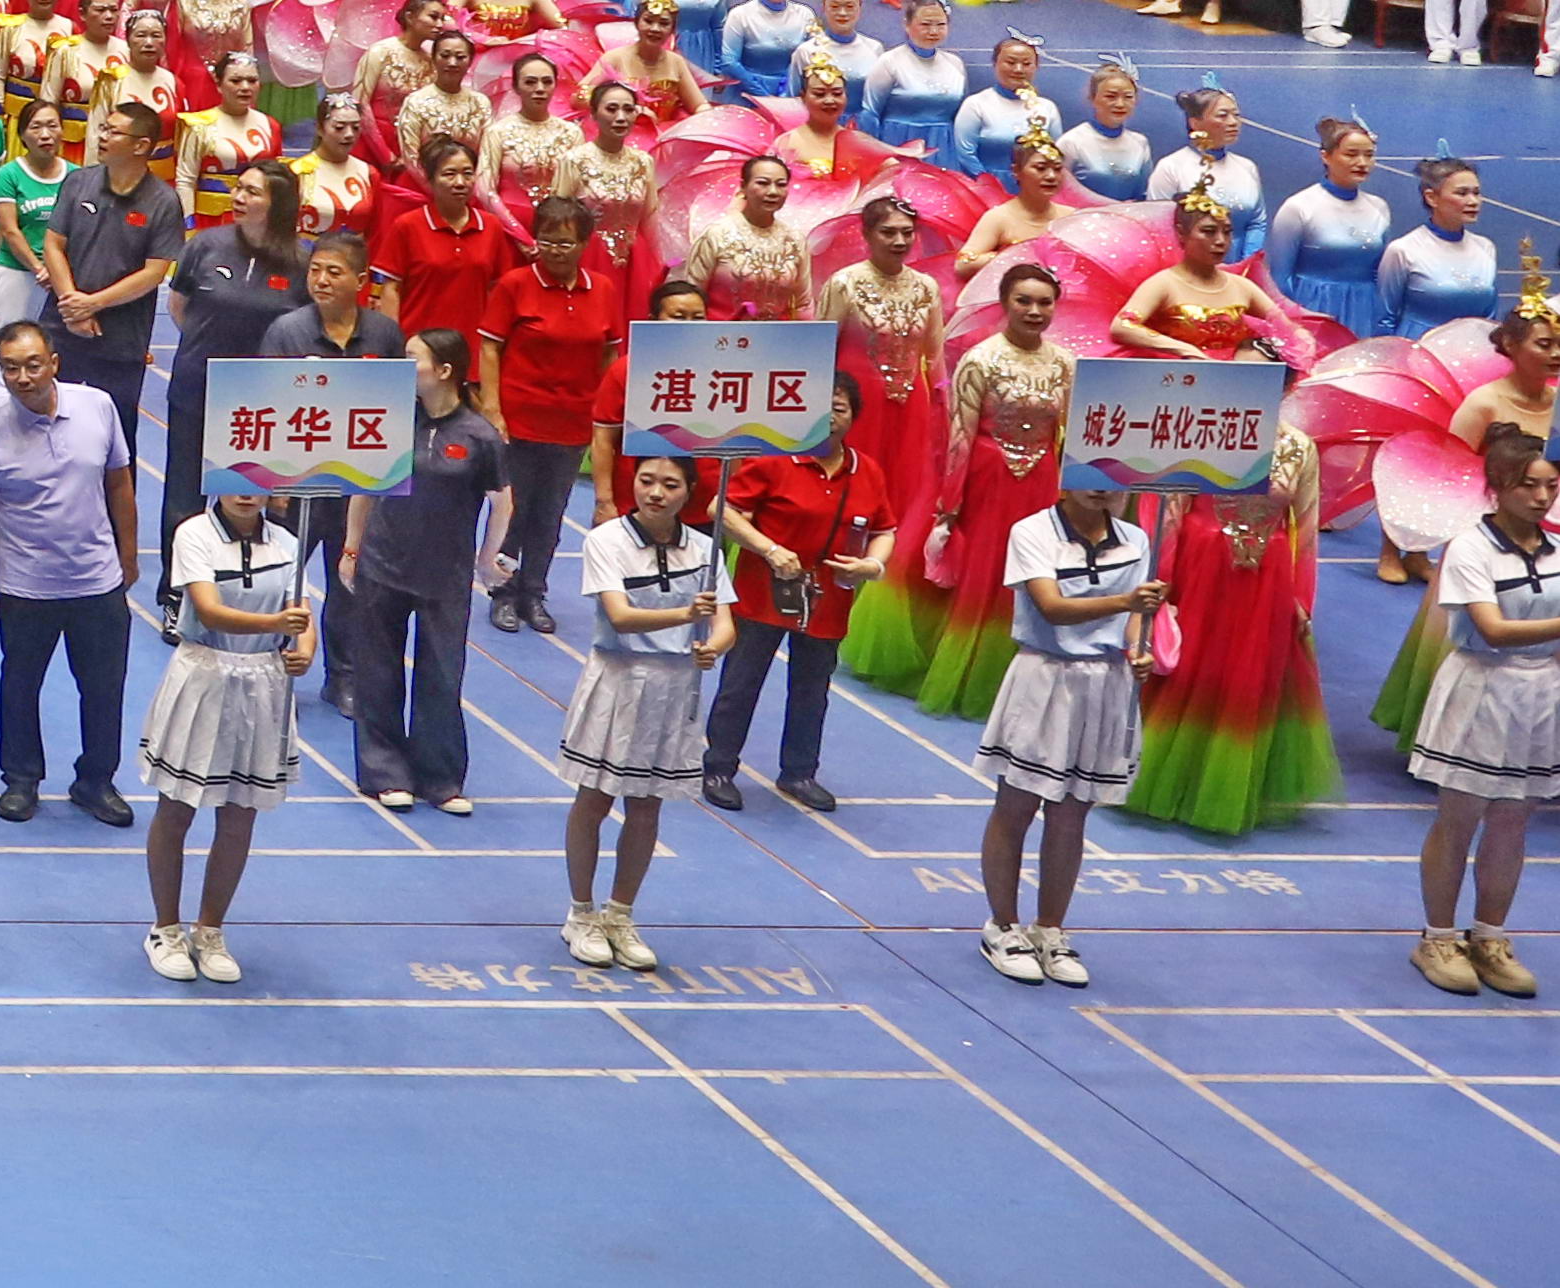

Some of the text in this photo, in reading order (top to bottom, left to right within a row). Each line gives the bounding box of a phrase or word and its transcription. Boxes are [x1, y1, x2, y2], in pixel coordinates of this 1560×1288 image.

[651, 368, 809, 414] 湛河区
[229, 406, 389, 452] 新华区
[1083, 405, 1263, 451] 城乡一体化示范区
